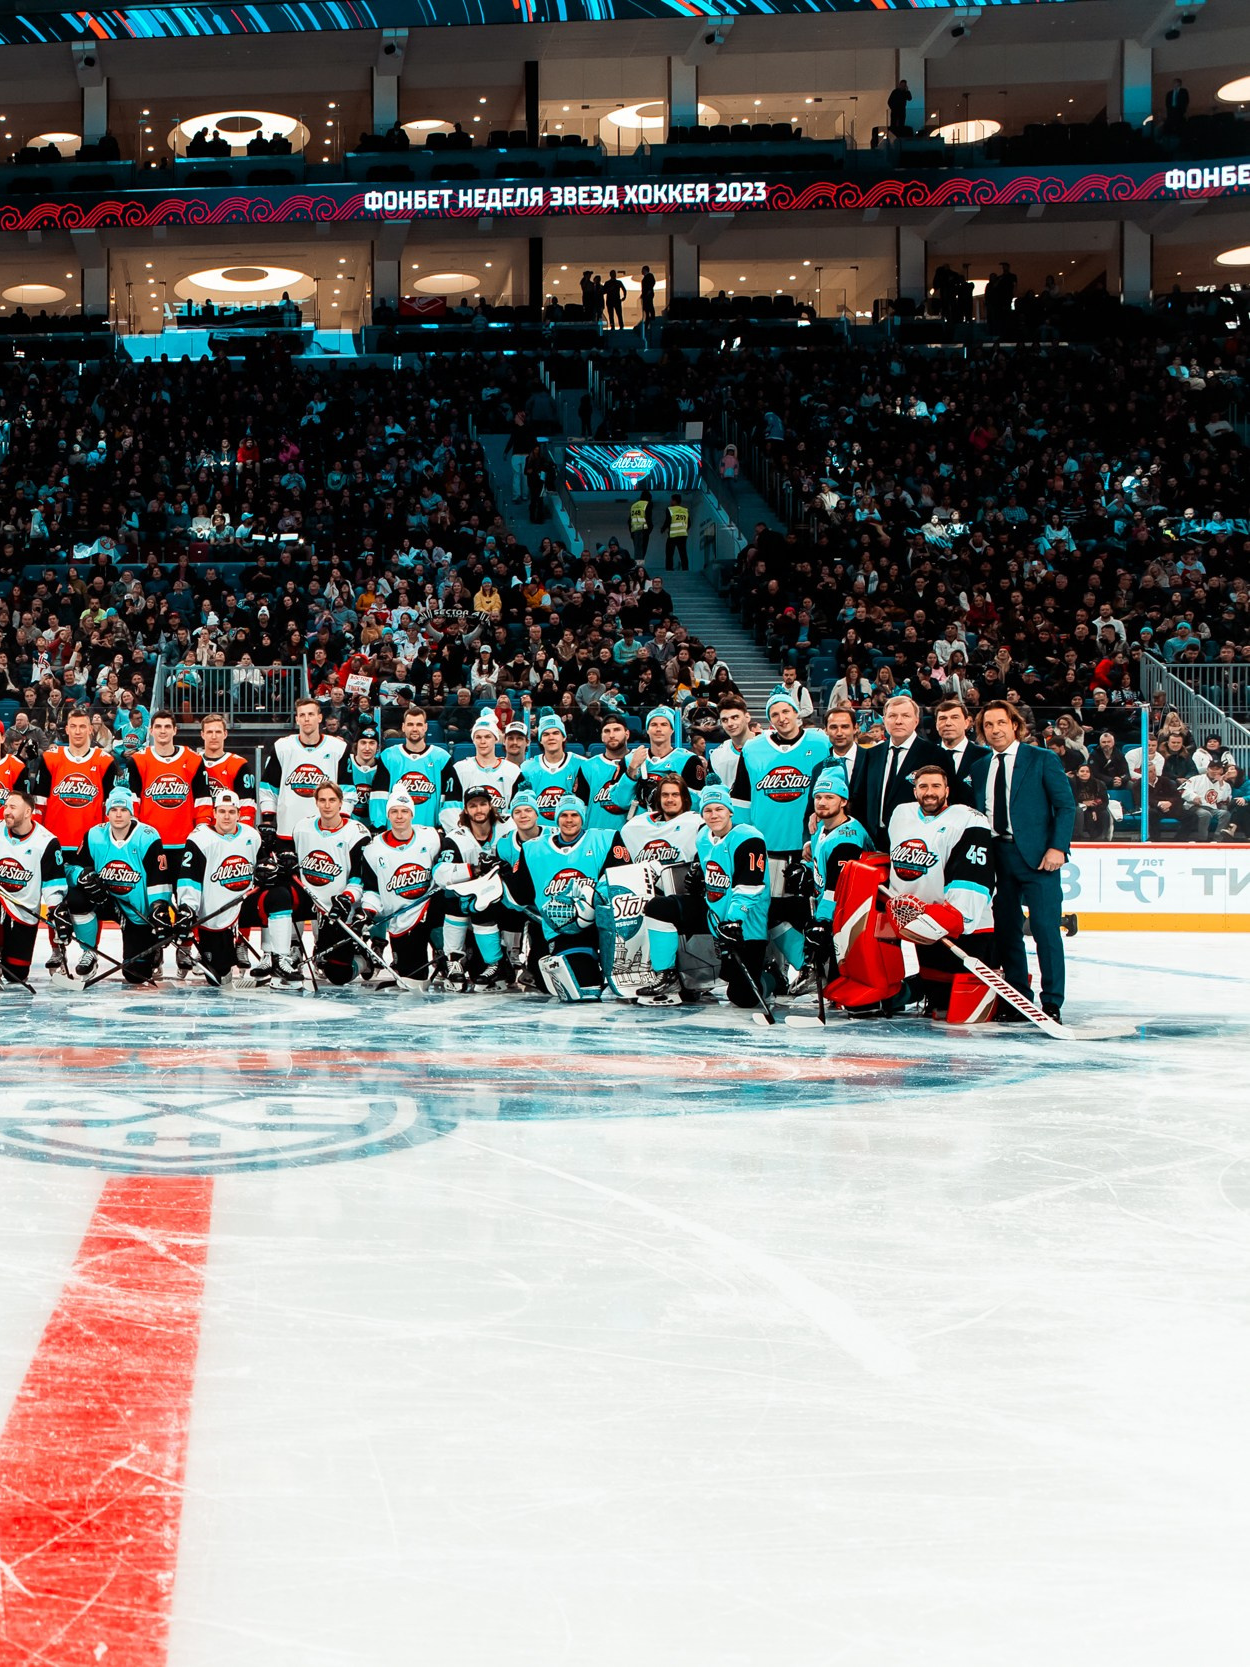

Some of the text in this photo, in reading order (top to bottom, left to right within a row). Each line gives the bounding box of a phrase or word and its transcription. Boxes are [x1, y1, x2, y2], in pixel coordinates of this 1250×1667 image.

[365, 182, 766, 211] ФОНБЕТ НЕДЕЛЯ ЗВЕЗД ХОККЕЯ 2023
[612, 456, 653, 468] All-Star
[54, 782, 98, 795] All-Star
[146, 782, 189, 796] All-Star
[757, 774, 810, 789] All-Star
[635, 846, 680, 863] All-Star
[749, 853, 764, 872] 14
[891, 846, 936, 865] All-Star
[966, 845, 988, 865] 45
[1142, 859, 1165, 867] лет
[100, 867, 141, 882] All-Star
[211, 863, 254, 882] All-Star
[301, 856, 342, 875] All-Star
[387, 868, 431, 890] All-Star
[614, 894, 648, 919] Star
[975, 966, 1048, 1022] WARRIOR
